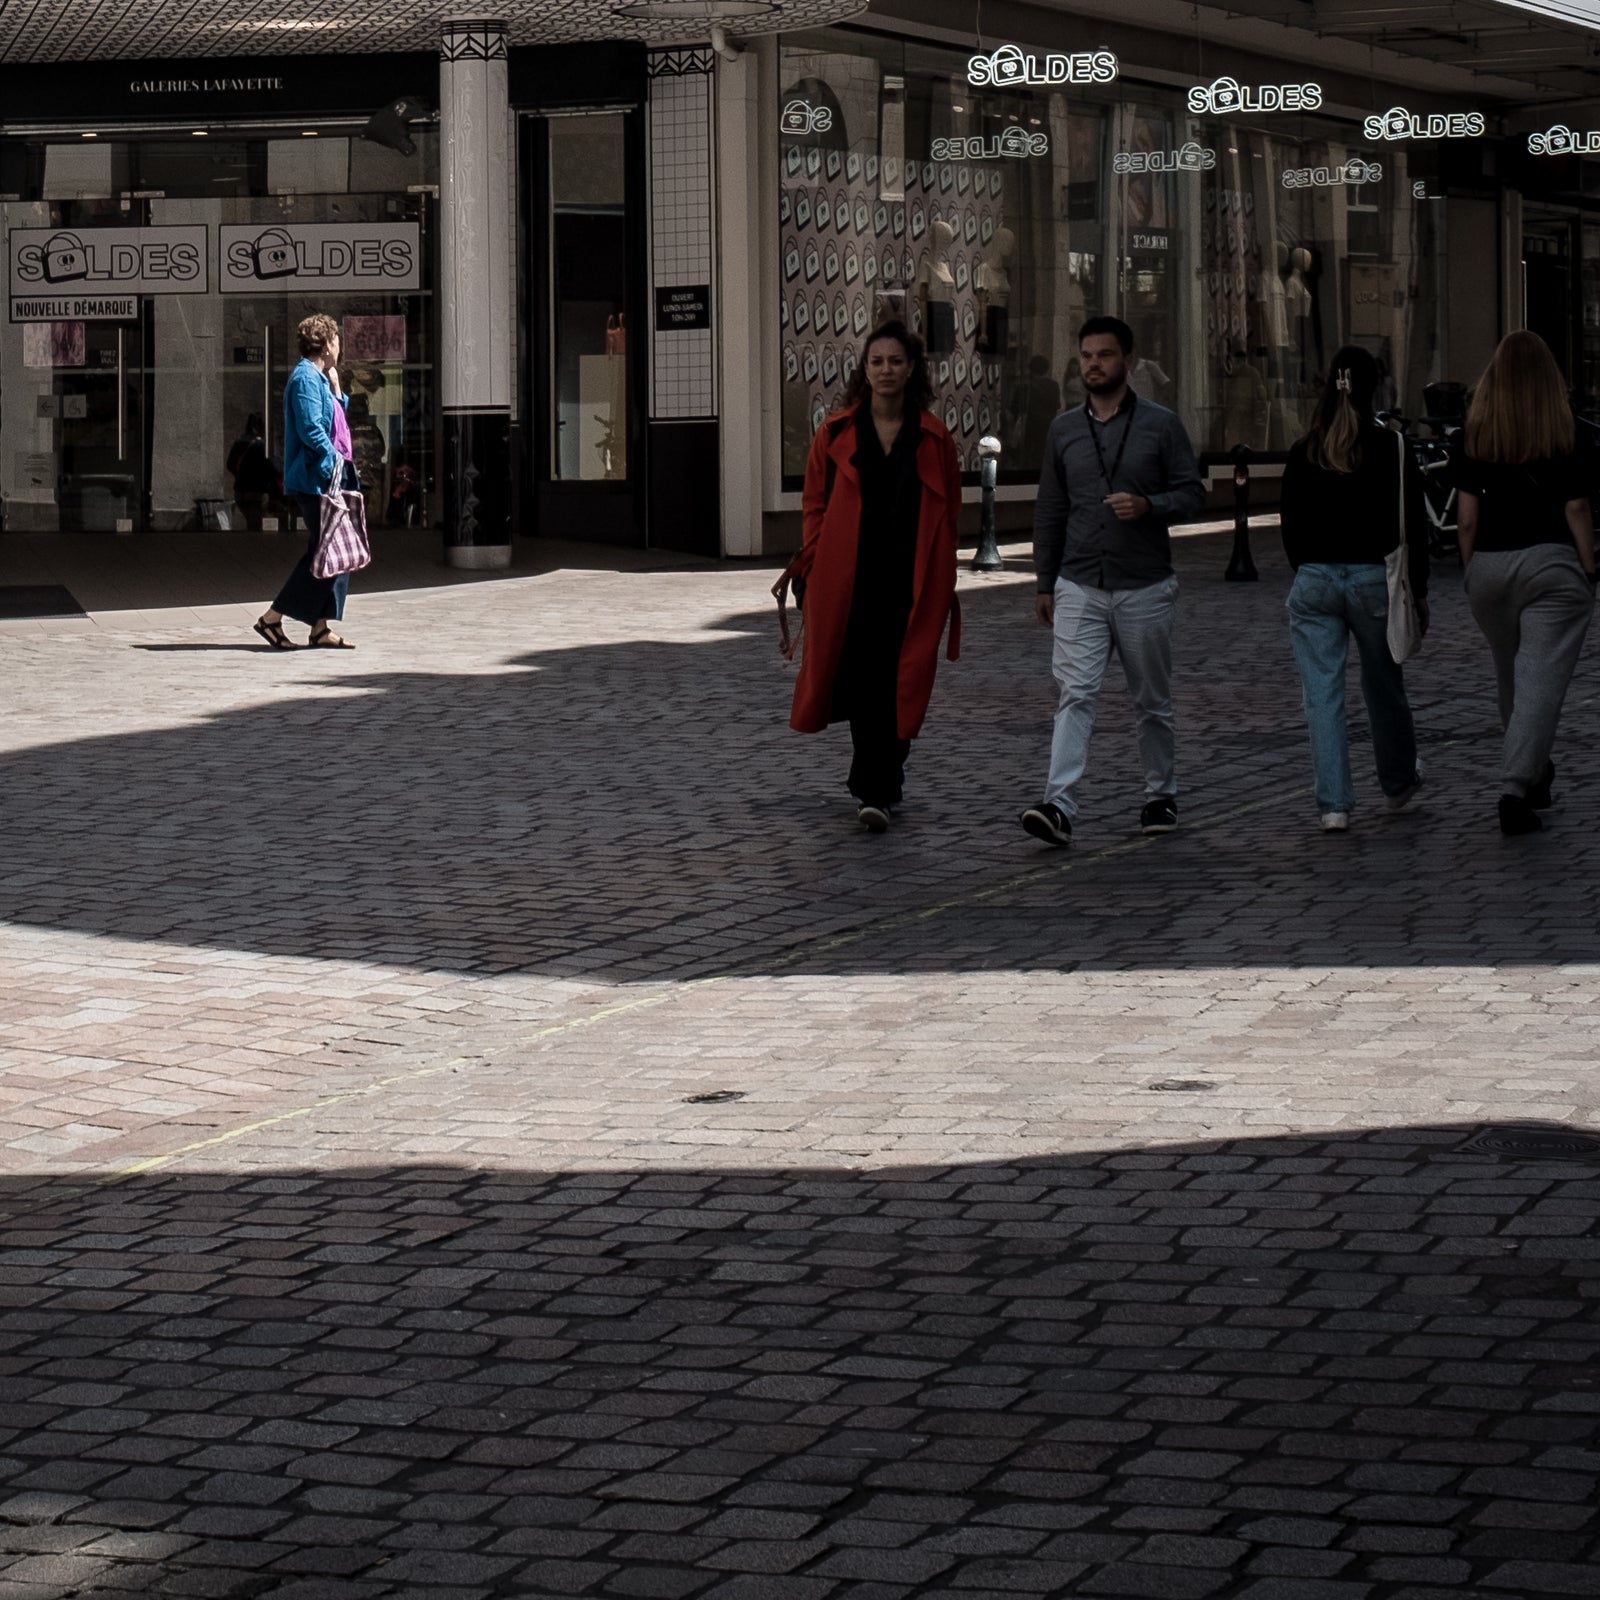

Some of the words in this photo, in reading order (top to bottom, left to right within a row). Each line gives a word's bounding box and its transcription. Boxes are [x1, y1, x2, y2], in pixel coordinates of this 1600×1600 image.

[129, 80, 201, 93] GALERIES
[203, 77, 284, 91] LAFAYETTE
[15, 300, 71, 318] NOUVELLE
[73, 298, 134, 318] DÉMARQUE
